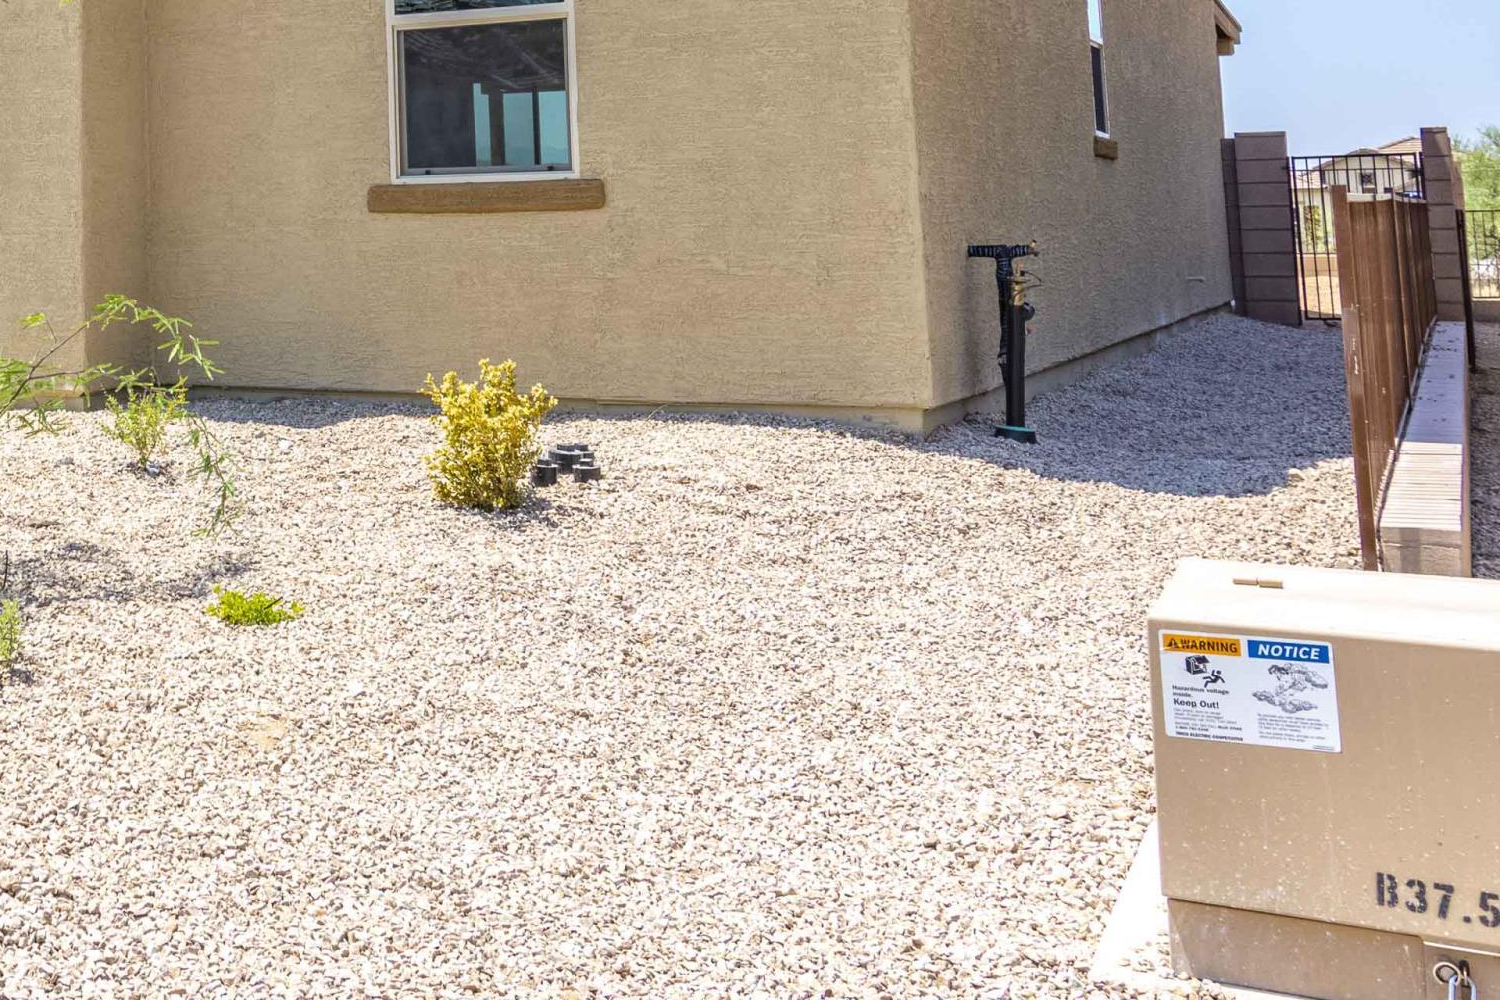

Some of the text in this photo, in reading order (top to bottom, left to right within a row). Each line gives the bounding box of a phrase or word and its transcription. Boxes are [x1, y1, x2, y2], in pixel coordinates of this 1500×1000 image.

[1180, 639, 1238, 654] WARNING
[1258, 644, 1320, 660] NOTICE
[1173, 698, 1220, 709] Keep Out!
[1376, 872, 1500, 928] B37.5
